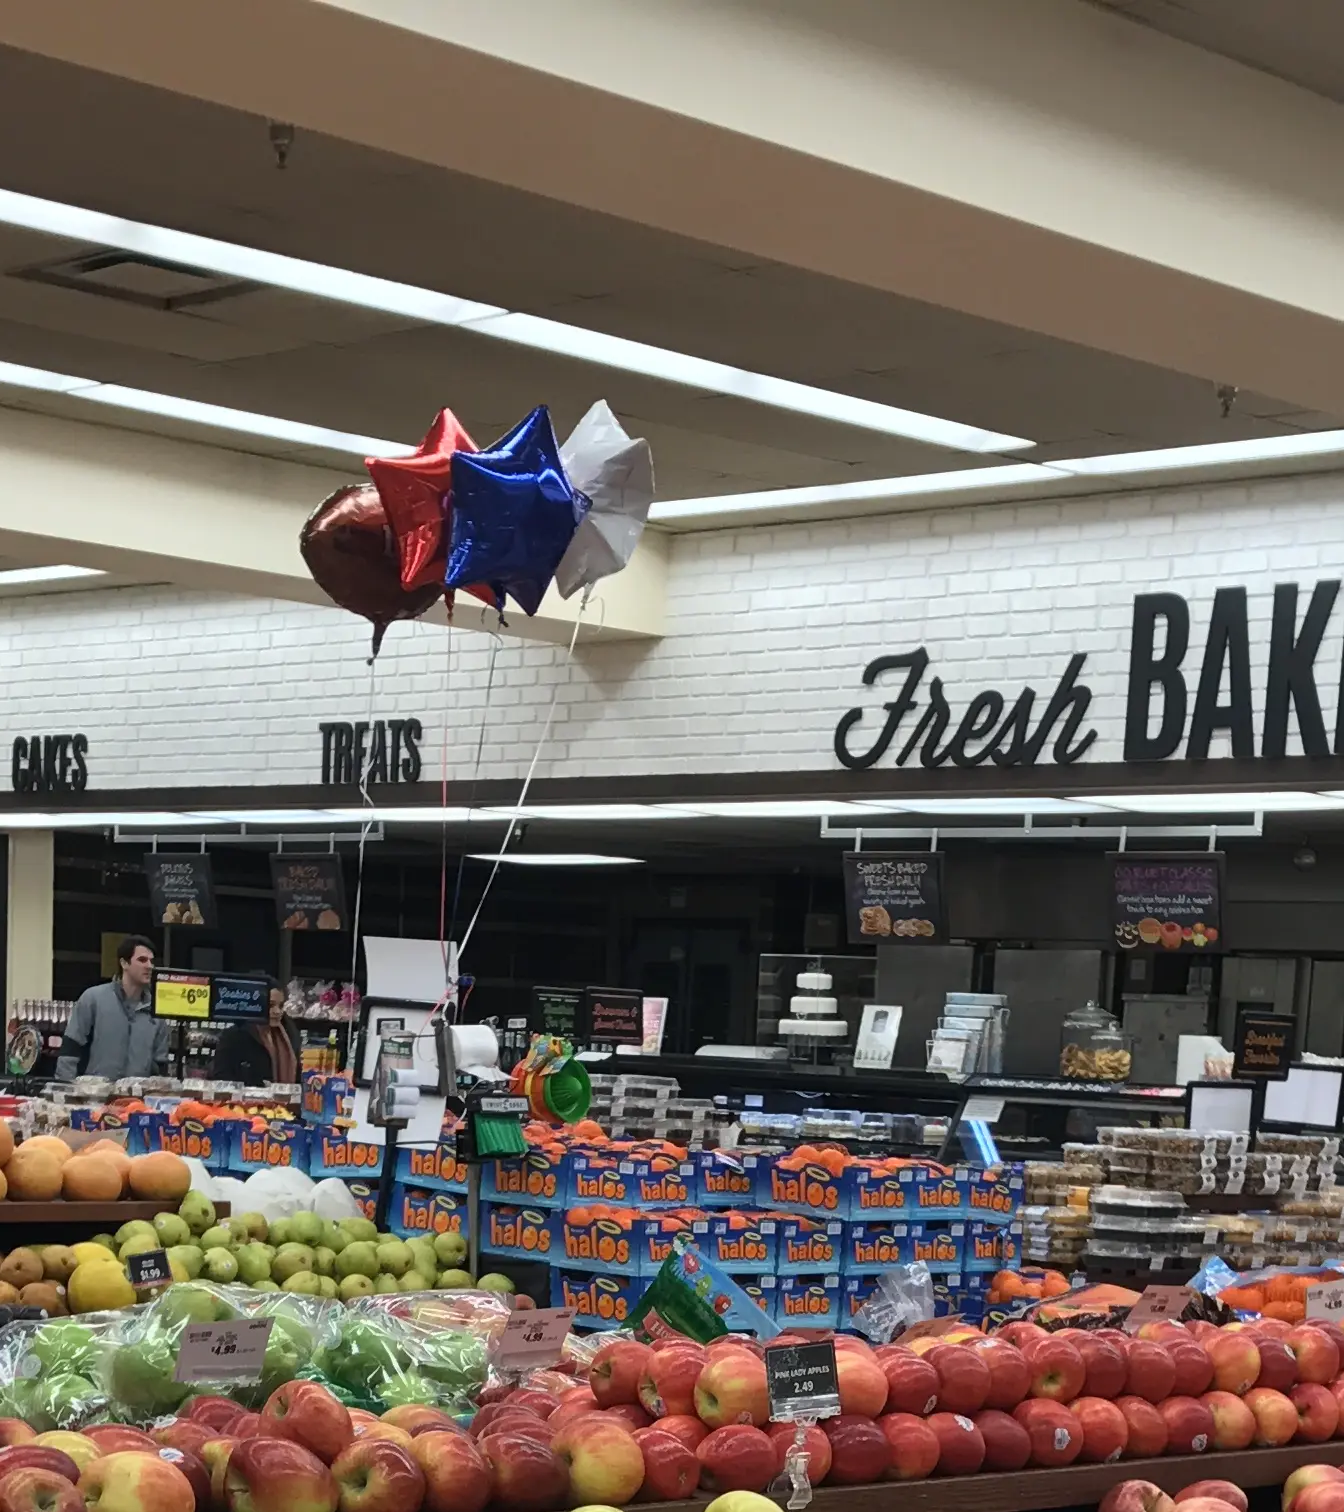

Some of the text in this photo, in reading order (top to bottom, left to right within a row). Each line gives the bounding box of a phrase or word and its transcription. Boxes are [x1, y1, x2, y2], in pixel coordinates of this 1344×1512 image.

[834, 646, 1098, 769] Fresh
[12, 734, 88, 791] CAKES
[319, 717, 422, 785] TREATS
[159, 1125, 212, 1158] halos
[241, 1131, 291, 1166] halos
[323, 1138, 378, 1168] halos
[411, 1149, 468, 1185] halos
[495, 1160, 556, 1198] halos
[705, 1170, 750, 1193] halos
[577, 1173, 626, 1200] halos
[640, 1179, 688, 1202] halos
[771, 1169, 839, 1210] halos
[860, 1186, 904, 1209] halos
[919, 1185, 960, 1207] halos
[970, 1186, 1012, 1213] halos
[403, 1197, 461, 1234] halos
[490, 1213, 551, 1252] halos
[564, 1224, 629, 1264] halos
[717, 1237, 767, 1262] halos
[787, 1240, 833, 1263] halos
[855, 1241, 899, 1263] halos
[914, 1238, 956, 1261] halos
[563, 1281, 627, 1321] halos
[784, 1292, 830, 1316] halos
[794, 1381, 814, 1393] 2.49
